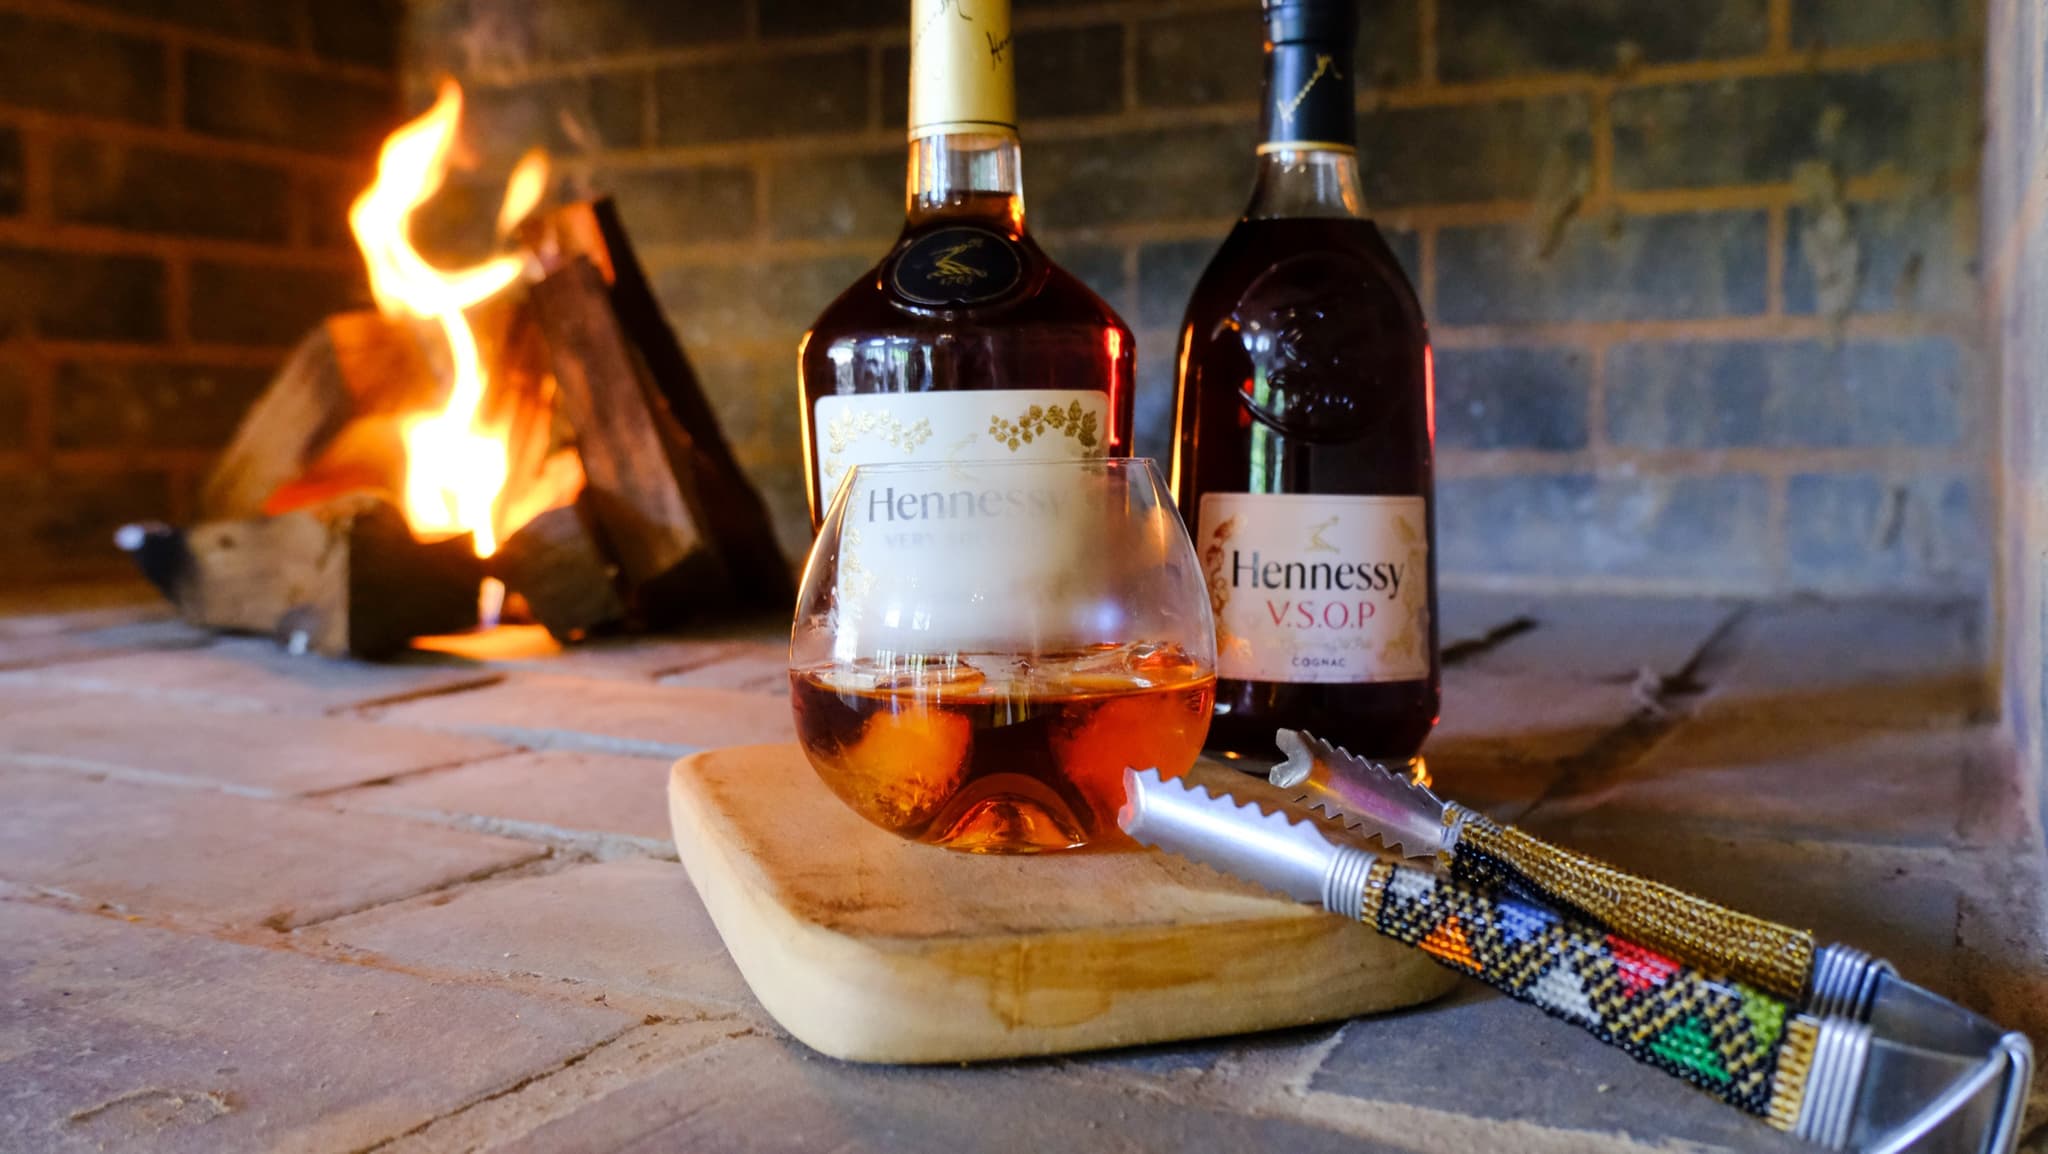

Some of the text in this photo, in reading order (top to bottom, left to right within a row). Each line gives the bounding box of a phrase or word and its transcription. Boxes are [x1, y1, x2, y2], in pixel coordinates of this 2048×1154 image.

[1232, 550, 1405, 599] Hennessy
[1266, 600, 1376, 630] V.S.O.P
[1291, 656, 1346, 668] COGNAC
